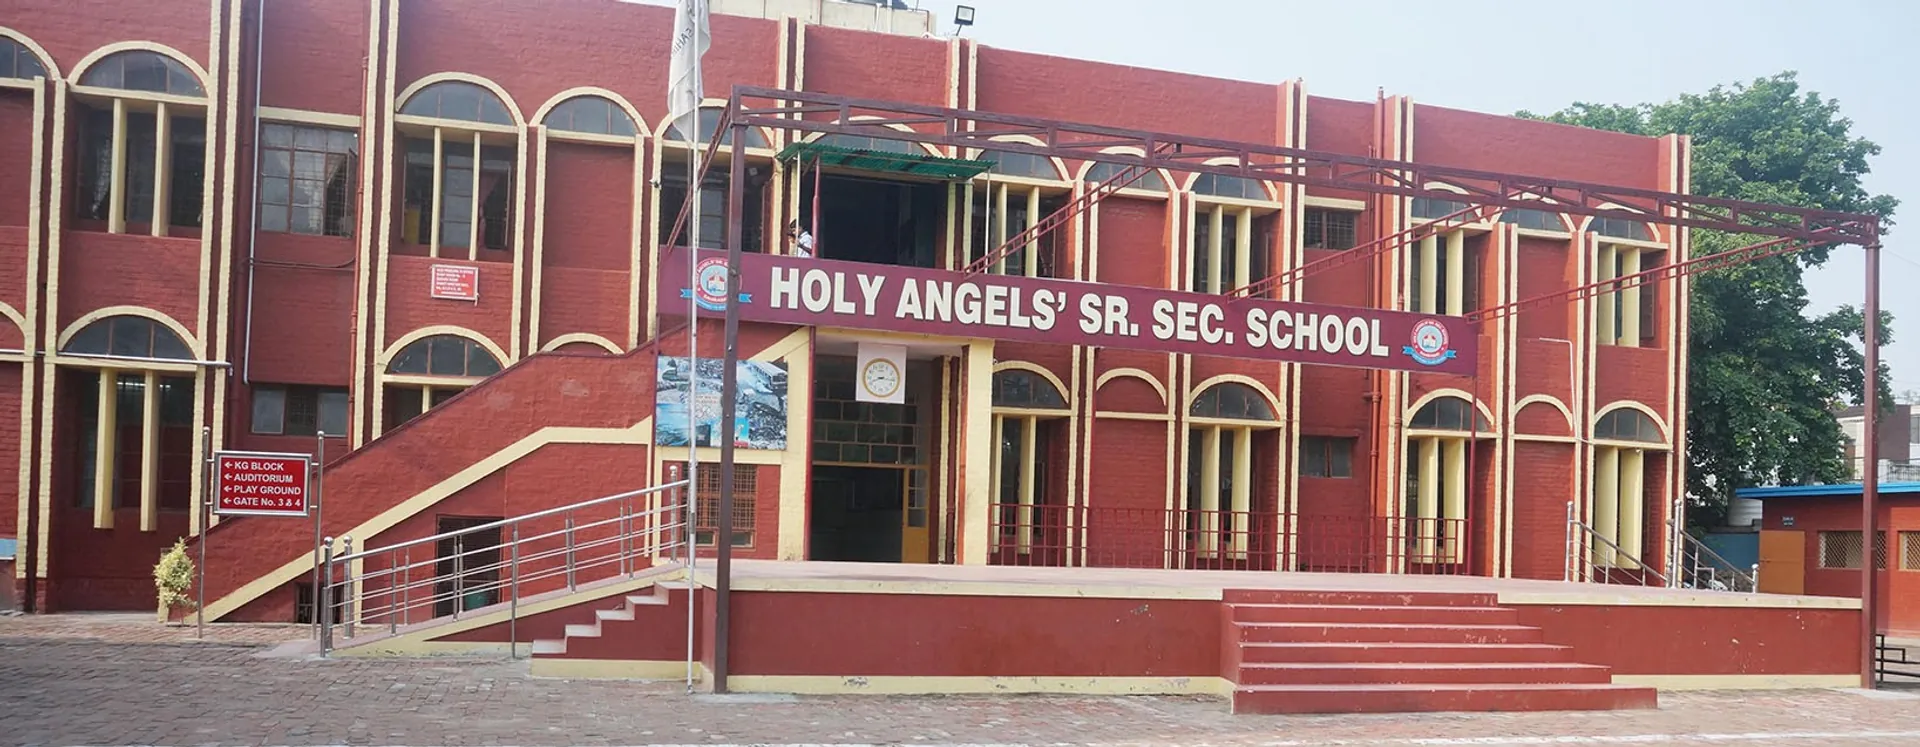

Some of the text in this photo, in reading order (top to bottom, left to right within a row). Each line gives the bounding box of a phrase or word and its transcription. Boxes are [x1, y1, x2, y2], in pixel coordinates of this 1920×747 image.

[770, 266, 886, 316] HOLY
[895, 278, 1067, 331] ANGELS'
[1079, 292, 1139, 336] SR.
[1152, 299, 1234, 344] SEC.
[1245, 307, 1389, 357] SCHOOL
[234, 461, 284, 471] KG BLOCK
[233, 473, 293, 483] AUDITORIUM
[233, 485, 301, 495] PLAY GROUND
[233, 497, 301, 507] GATE No. 3 & 4
